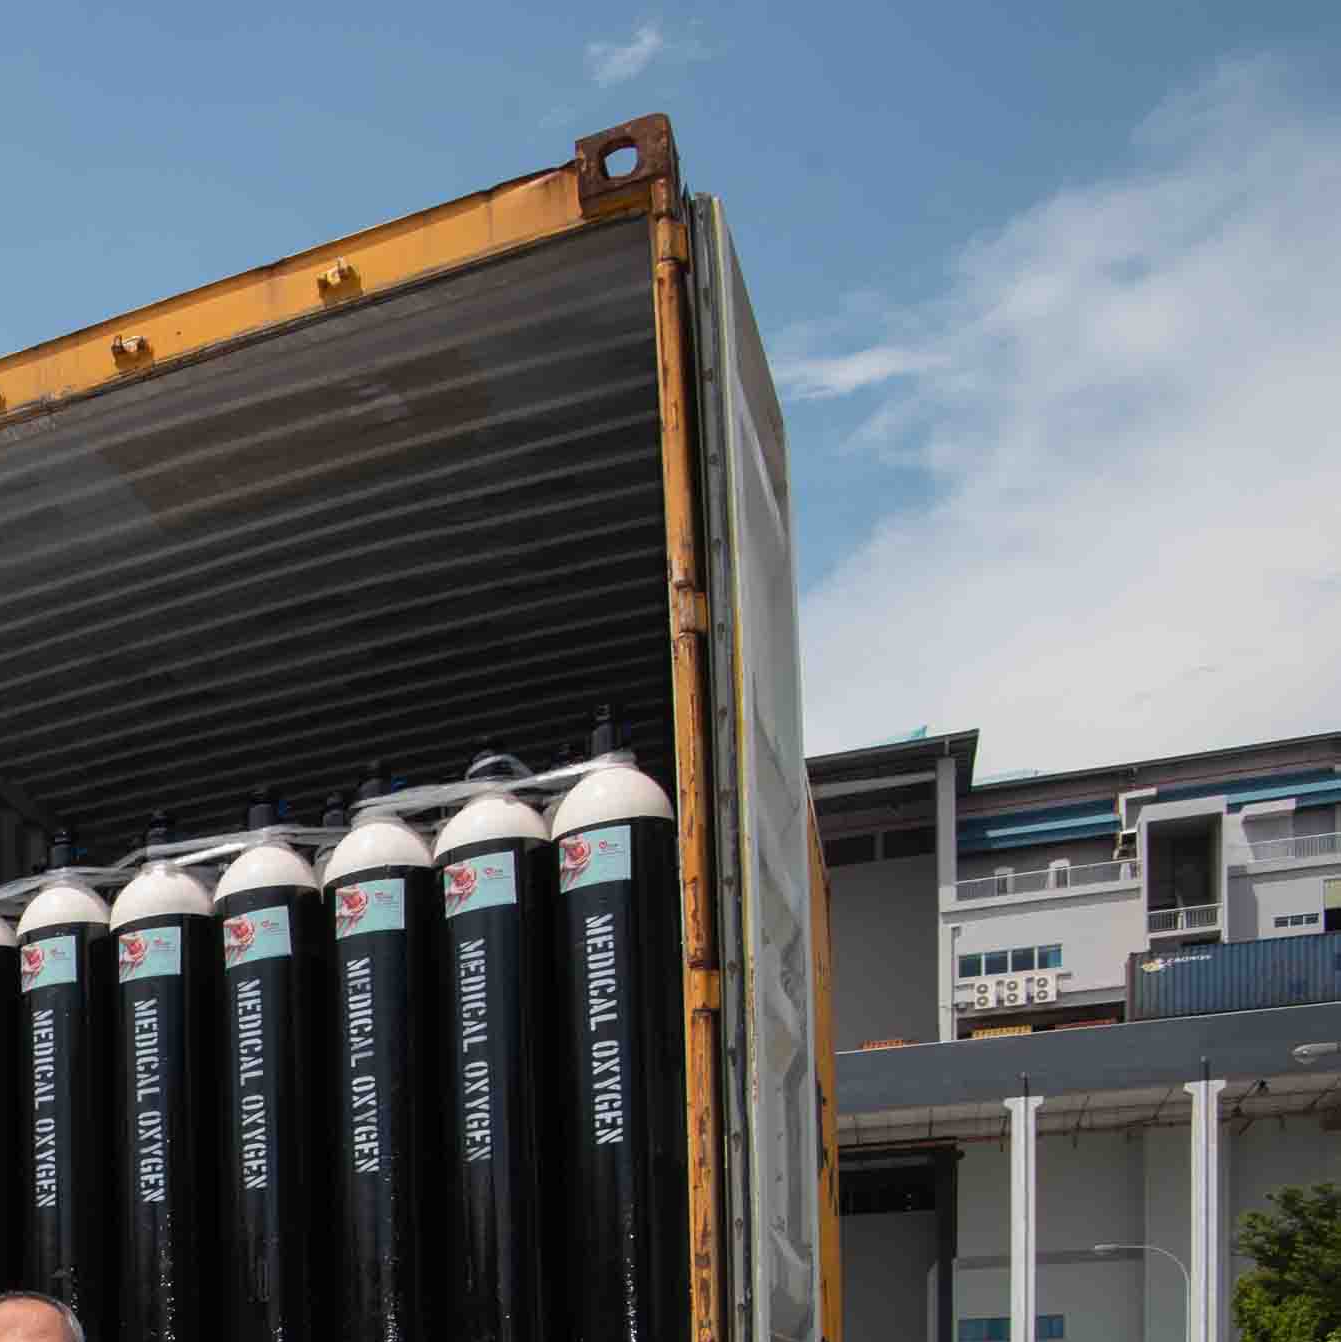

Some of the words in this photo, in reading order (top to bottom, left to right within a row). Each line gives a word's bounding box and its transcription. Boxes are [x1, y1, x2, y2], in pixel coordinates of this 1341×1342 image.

[346, 956, 375, 1068] MEDICAL
[459, 937, 488, 1054] MEDICAL
[584, 912, 618, 1033] MEDICAL
[31, 1008, 57, 1110] MEDICAL
[133, 998, 161, 1104] MEDICAL
[236, 977, 264, 1088] MEDICAL
[241, 1094, 269, 1190] OXYGEN
[351, 1075, 381, 1174] OXYGEN
[463, 1060, 493, 1163] OXYGEN
[590, 1039, 625, 1146] OXYGEN
[34, 1117, 58, 1208] OXYGEN
[136, 1110, 166, 1204] OXYGEN
